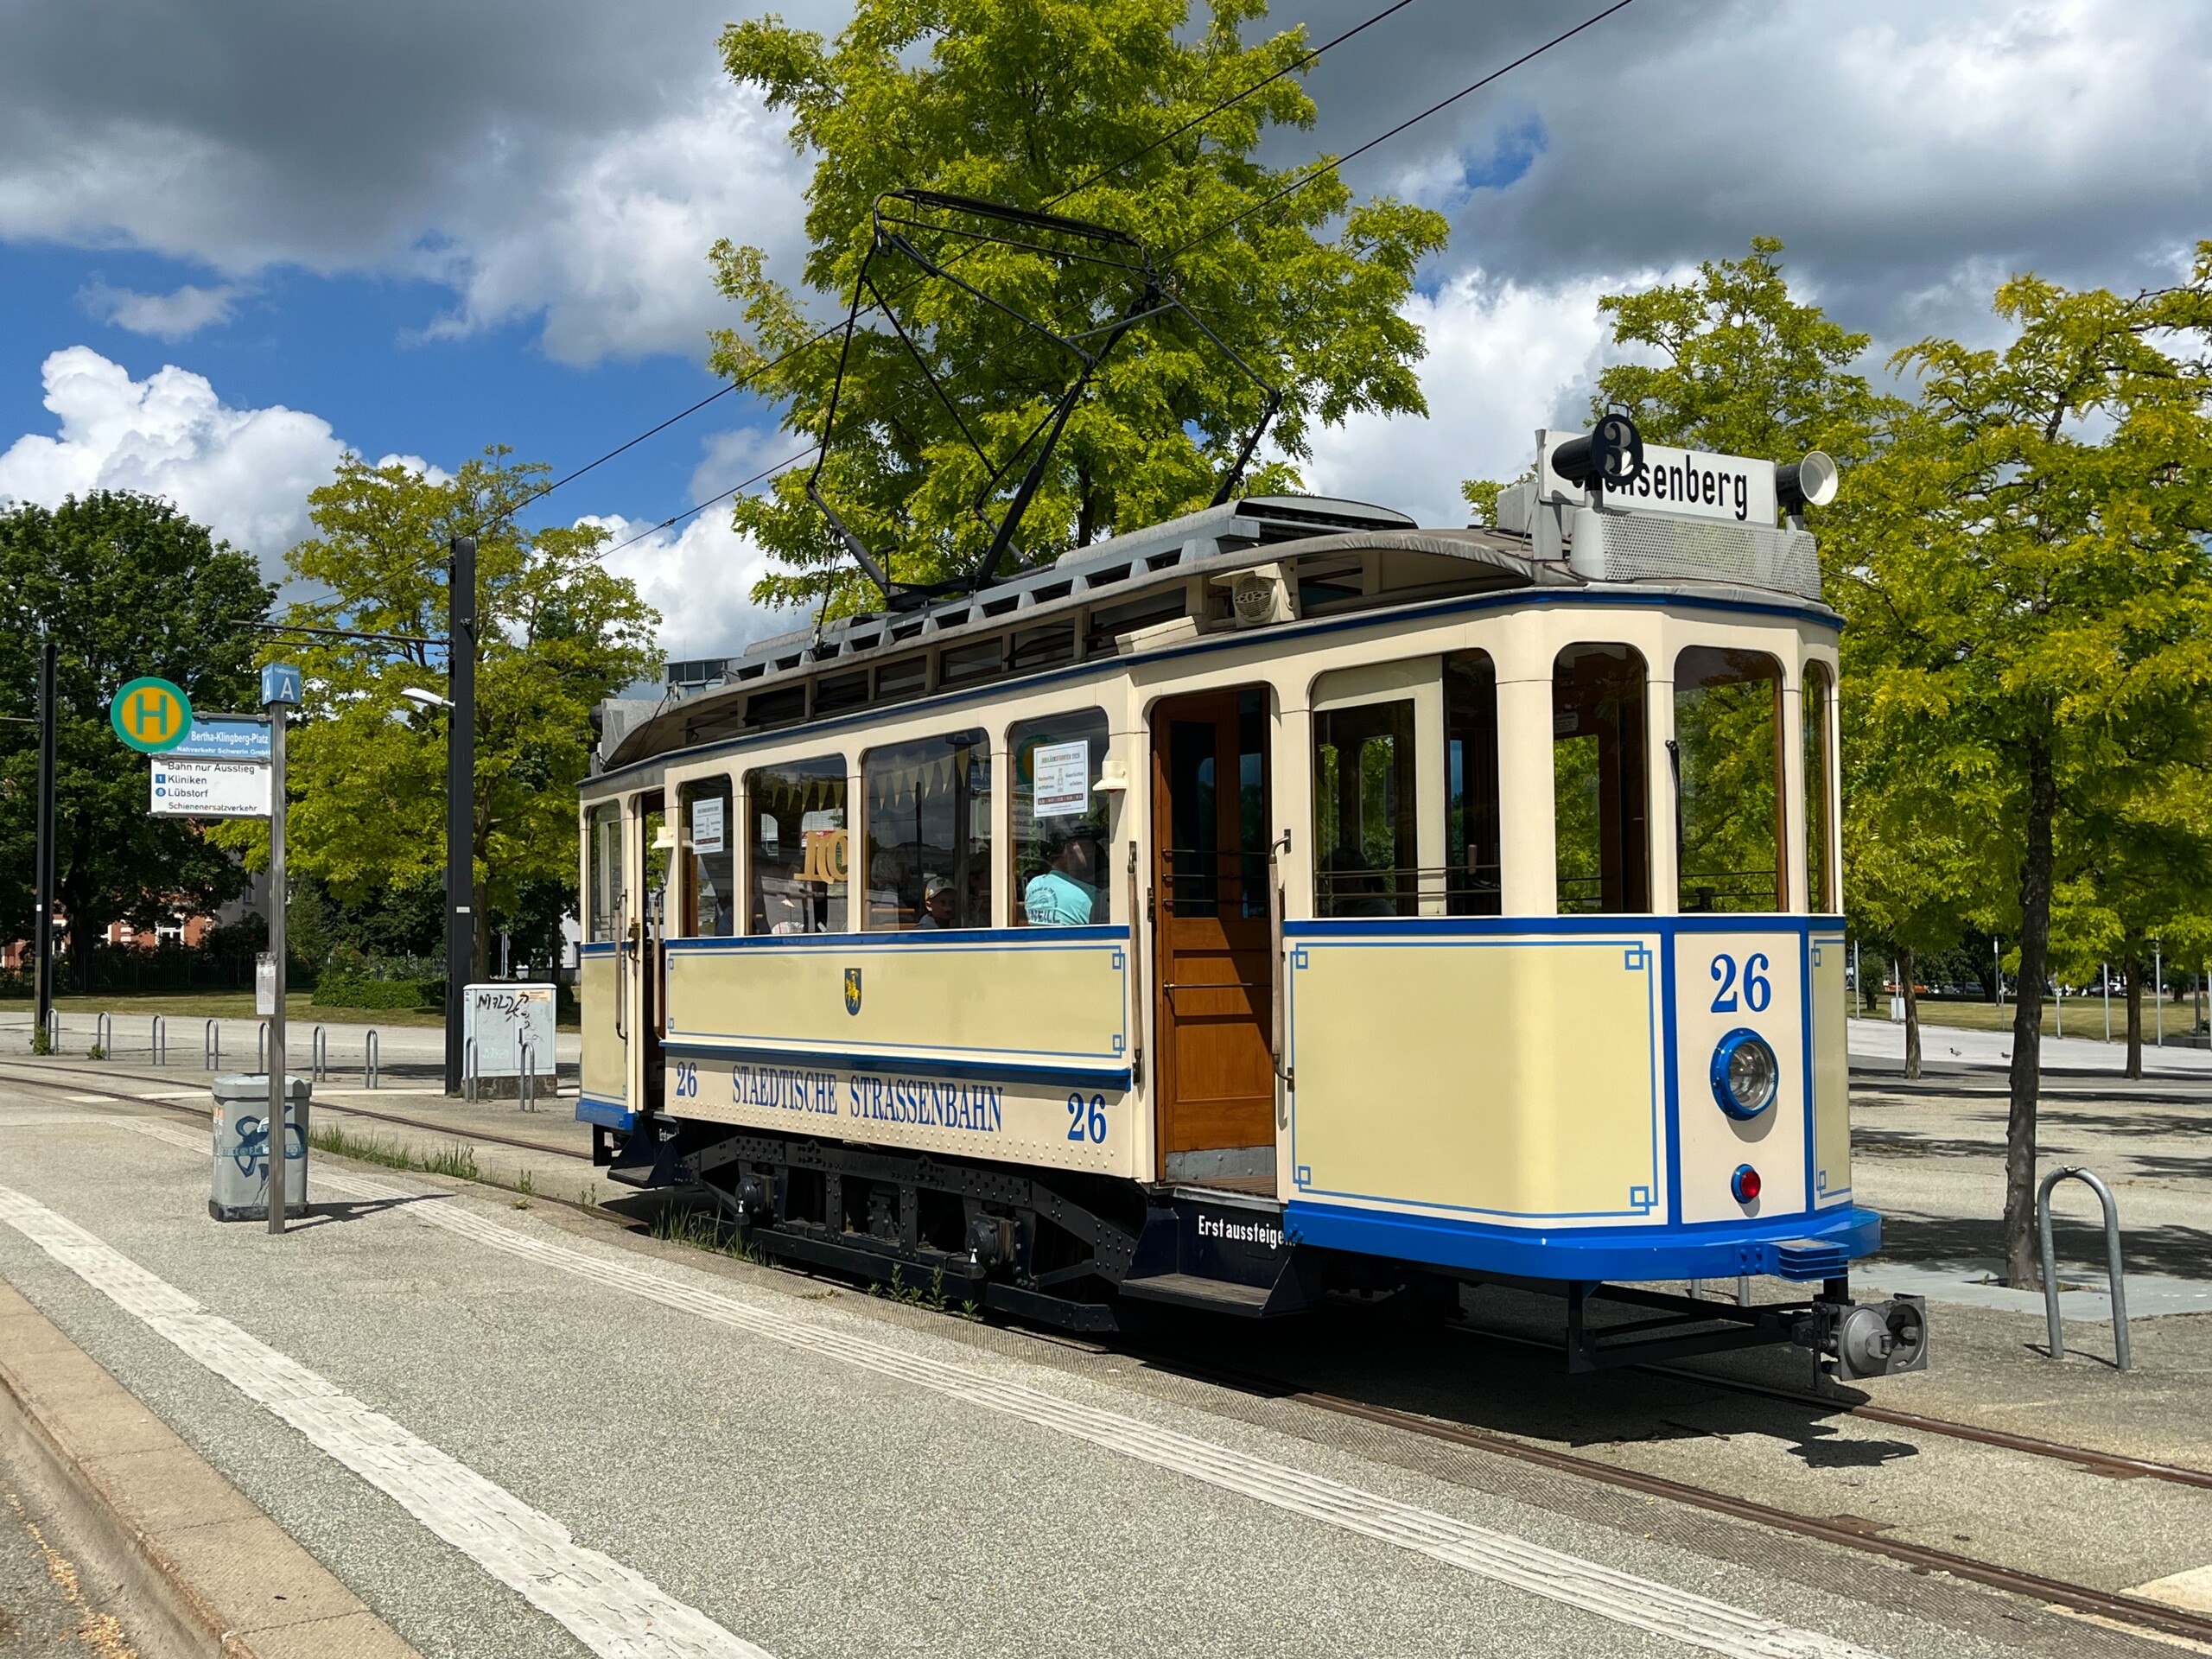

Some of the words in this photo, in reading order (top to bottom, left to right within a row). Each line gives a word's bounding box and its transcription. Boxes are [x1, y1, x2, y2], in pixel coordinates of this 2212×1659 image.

[1604, 421, 1634, 477] 3
[279, 677, 295, 701] A
[136, 694, 168, 734] H
[191, 730, 269, 745] Bertha-Klingberg-Platz
[168, 761, 192, 771] Bahn
[213, 763, 255, 775] Ausstieg
[168, 775, 207, 785] Kliniken
[168, 787, 209, 798] Lübstorf
[168, 802, 257, 812] Schienenersatzverkehr
[1710, 952, 1771, 1013] 26
[677, 1061, 697, 1098] 26
[733, 1065, 837, 1115] STAEDTISCHE
[850, 1075, 1003, 1133] STRASSENBAHN
[1067, 1092, 1107, 1144] 26
